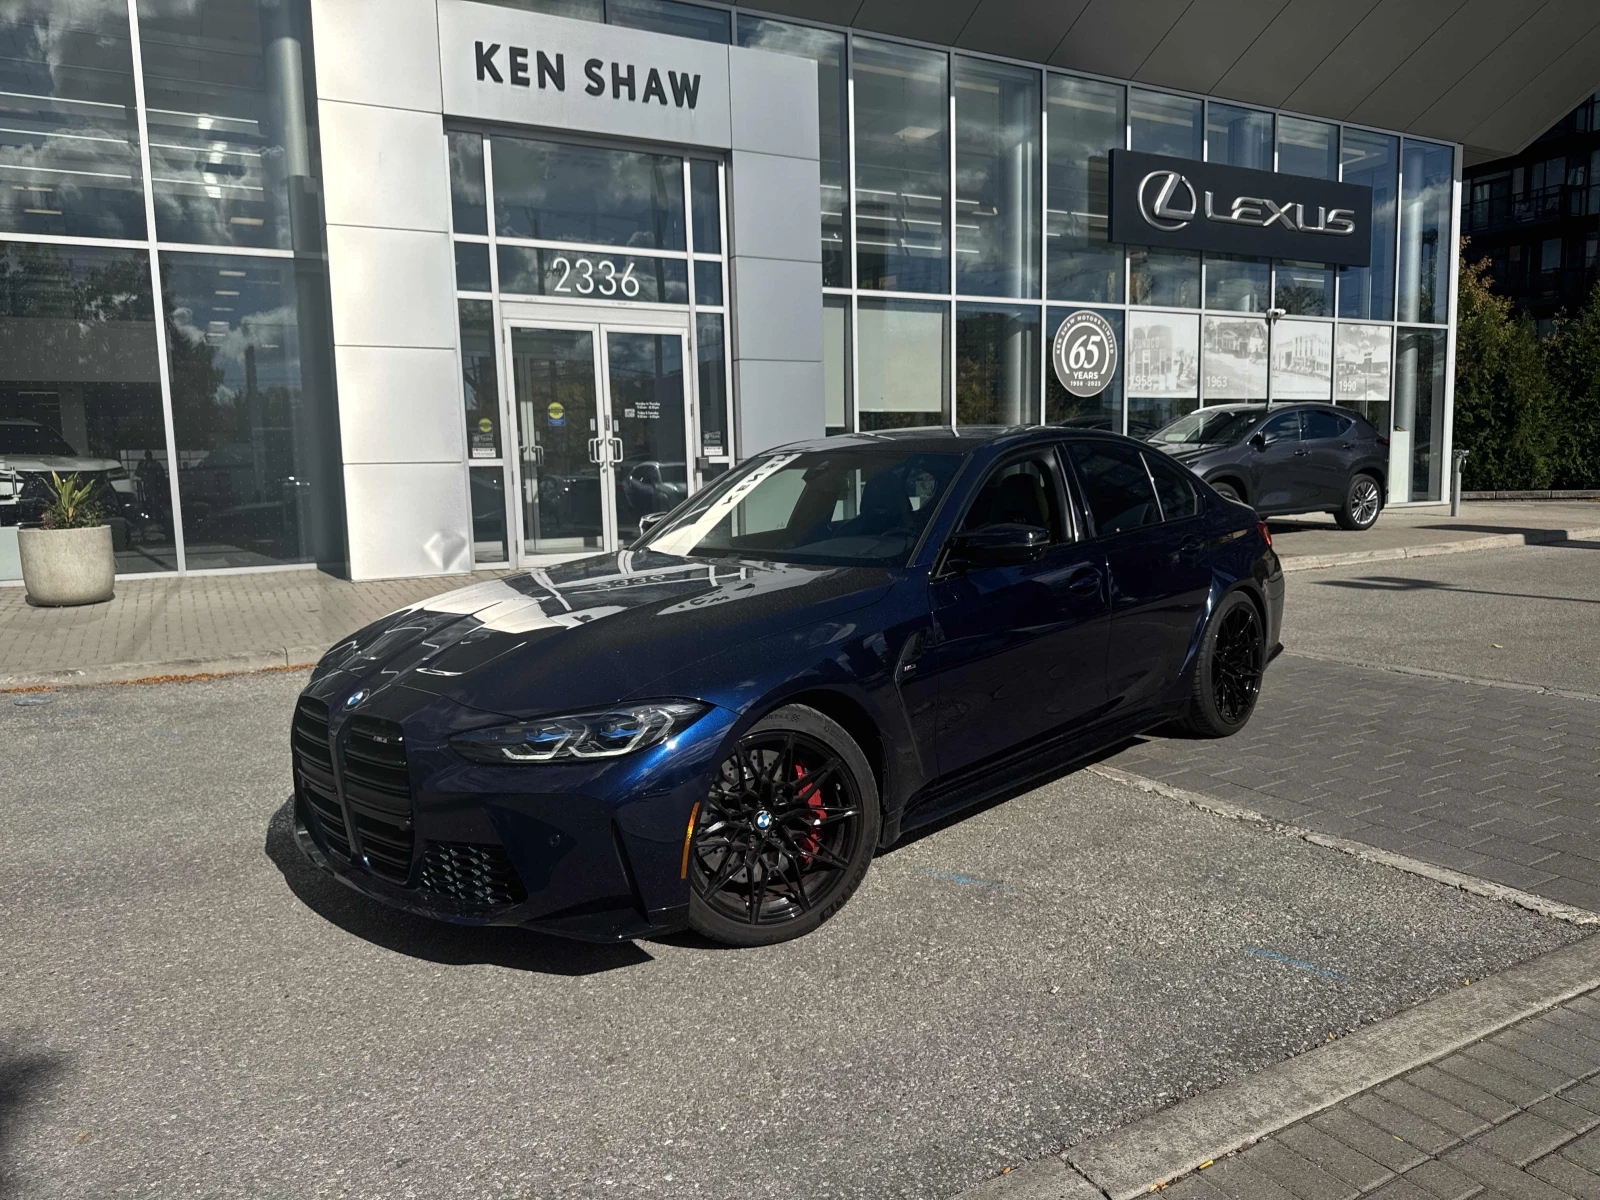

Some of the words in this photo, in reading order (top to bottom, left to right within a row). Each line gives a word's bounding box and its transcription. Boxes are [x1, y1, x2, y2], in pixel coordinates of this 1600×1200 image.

[474, 41, 565, 92] KEN
[584, 58, 701, 109] SHAW
[1204, 191, 1355, 237] LEXUS
[552, 257, 640, 297] 2336
[1061, 317, 1076, 336] SHAW
[1077, 315, 1101, 325] MOTORS
[1102, 324, 1114, 355] LIMITED
[1069, 334, 1101, 369] 65
[1073, 371, 1099, 380] YEARS
[1206, 376, 1228, 388] 1963
[1338, 381, 1357, 392] 1990
